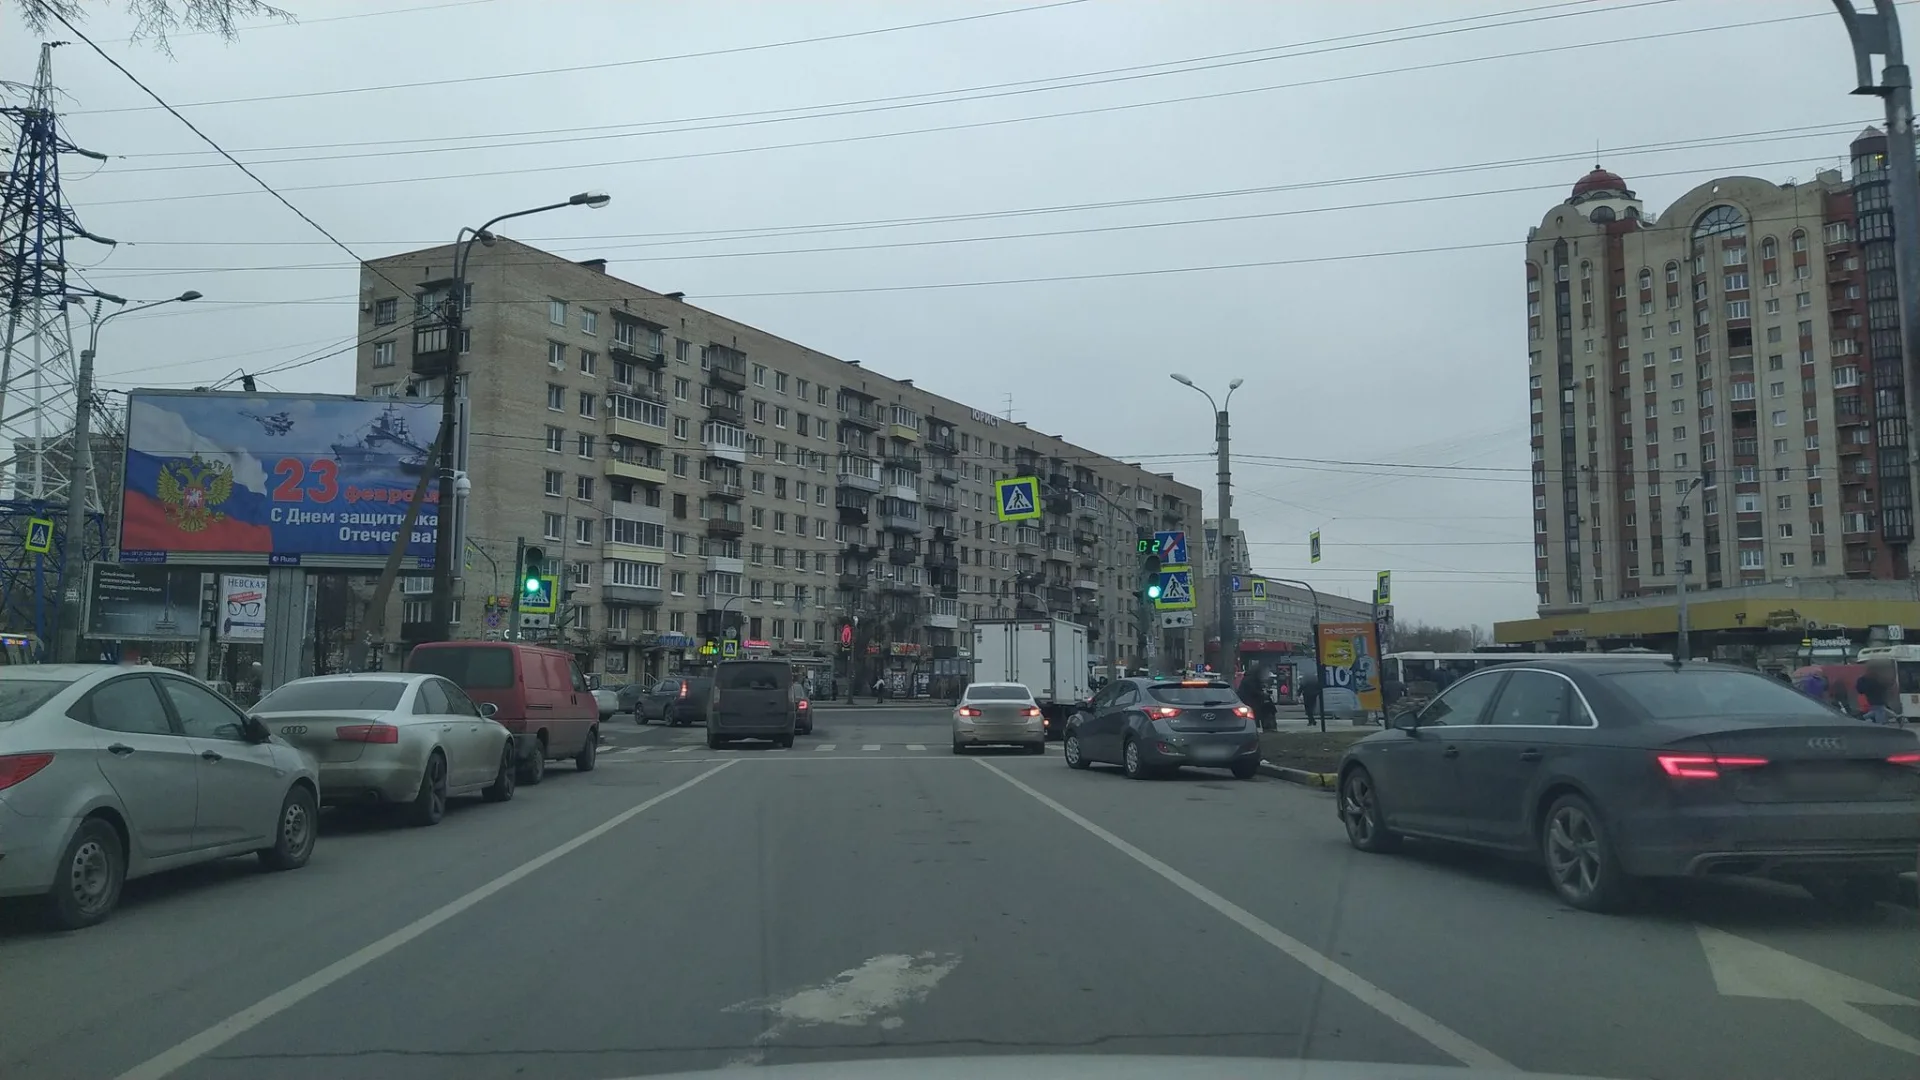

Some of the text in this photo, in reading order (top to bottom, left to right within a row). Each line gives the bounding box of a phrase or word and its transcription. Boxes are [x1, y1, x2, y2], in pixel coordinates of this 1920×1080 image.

[971, 408, 1000, 428] ЮРИСТ
[273, 457, 338, 503] 23
[270, 507, 282, 522] С
[286, 508, 335, 525] Днем
[339, 526, 438, 543] Отечесва!
[227, 578, 266, 590] НЕВСКАЯ
